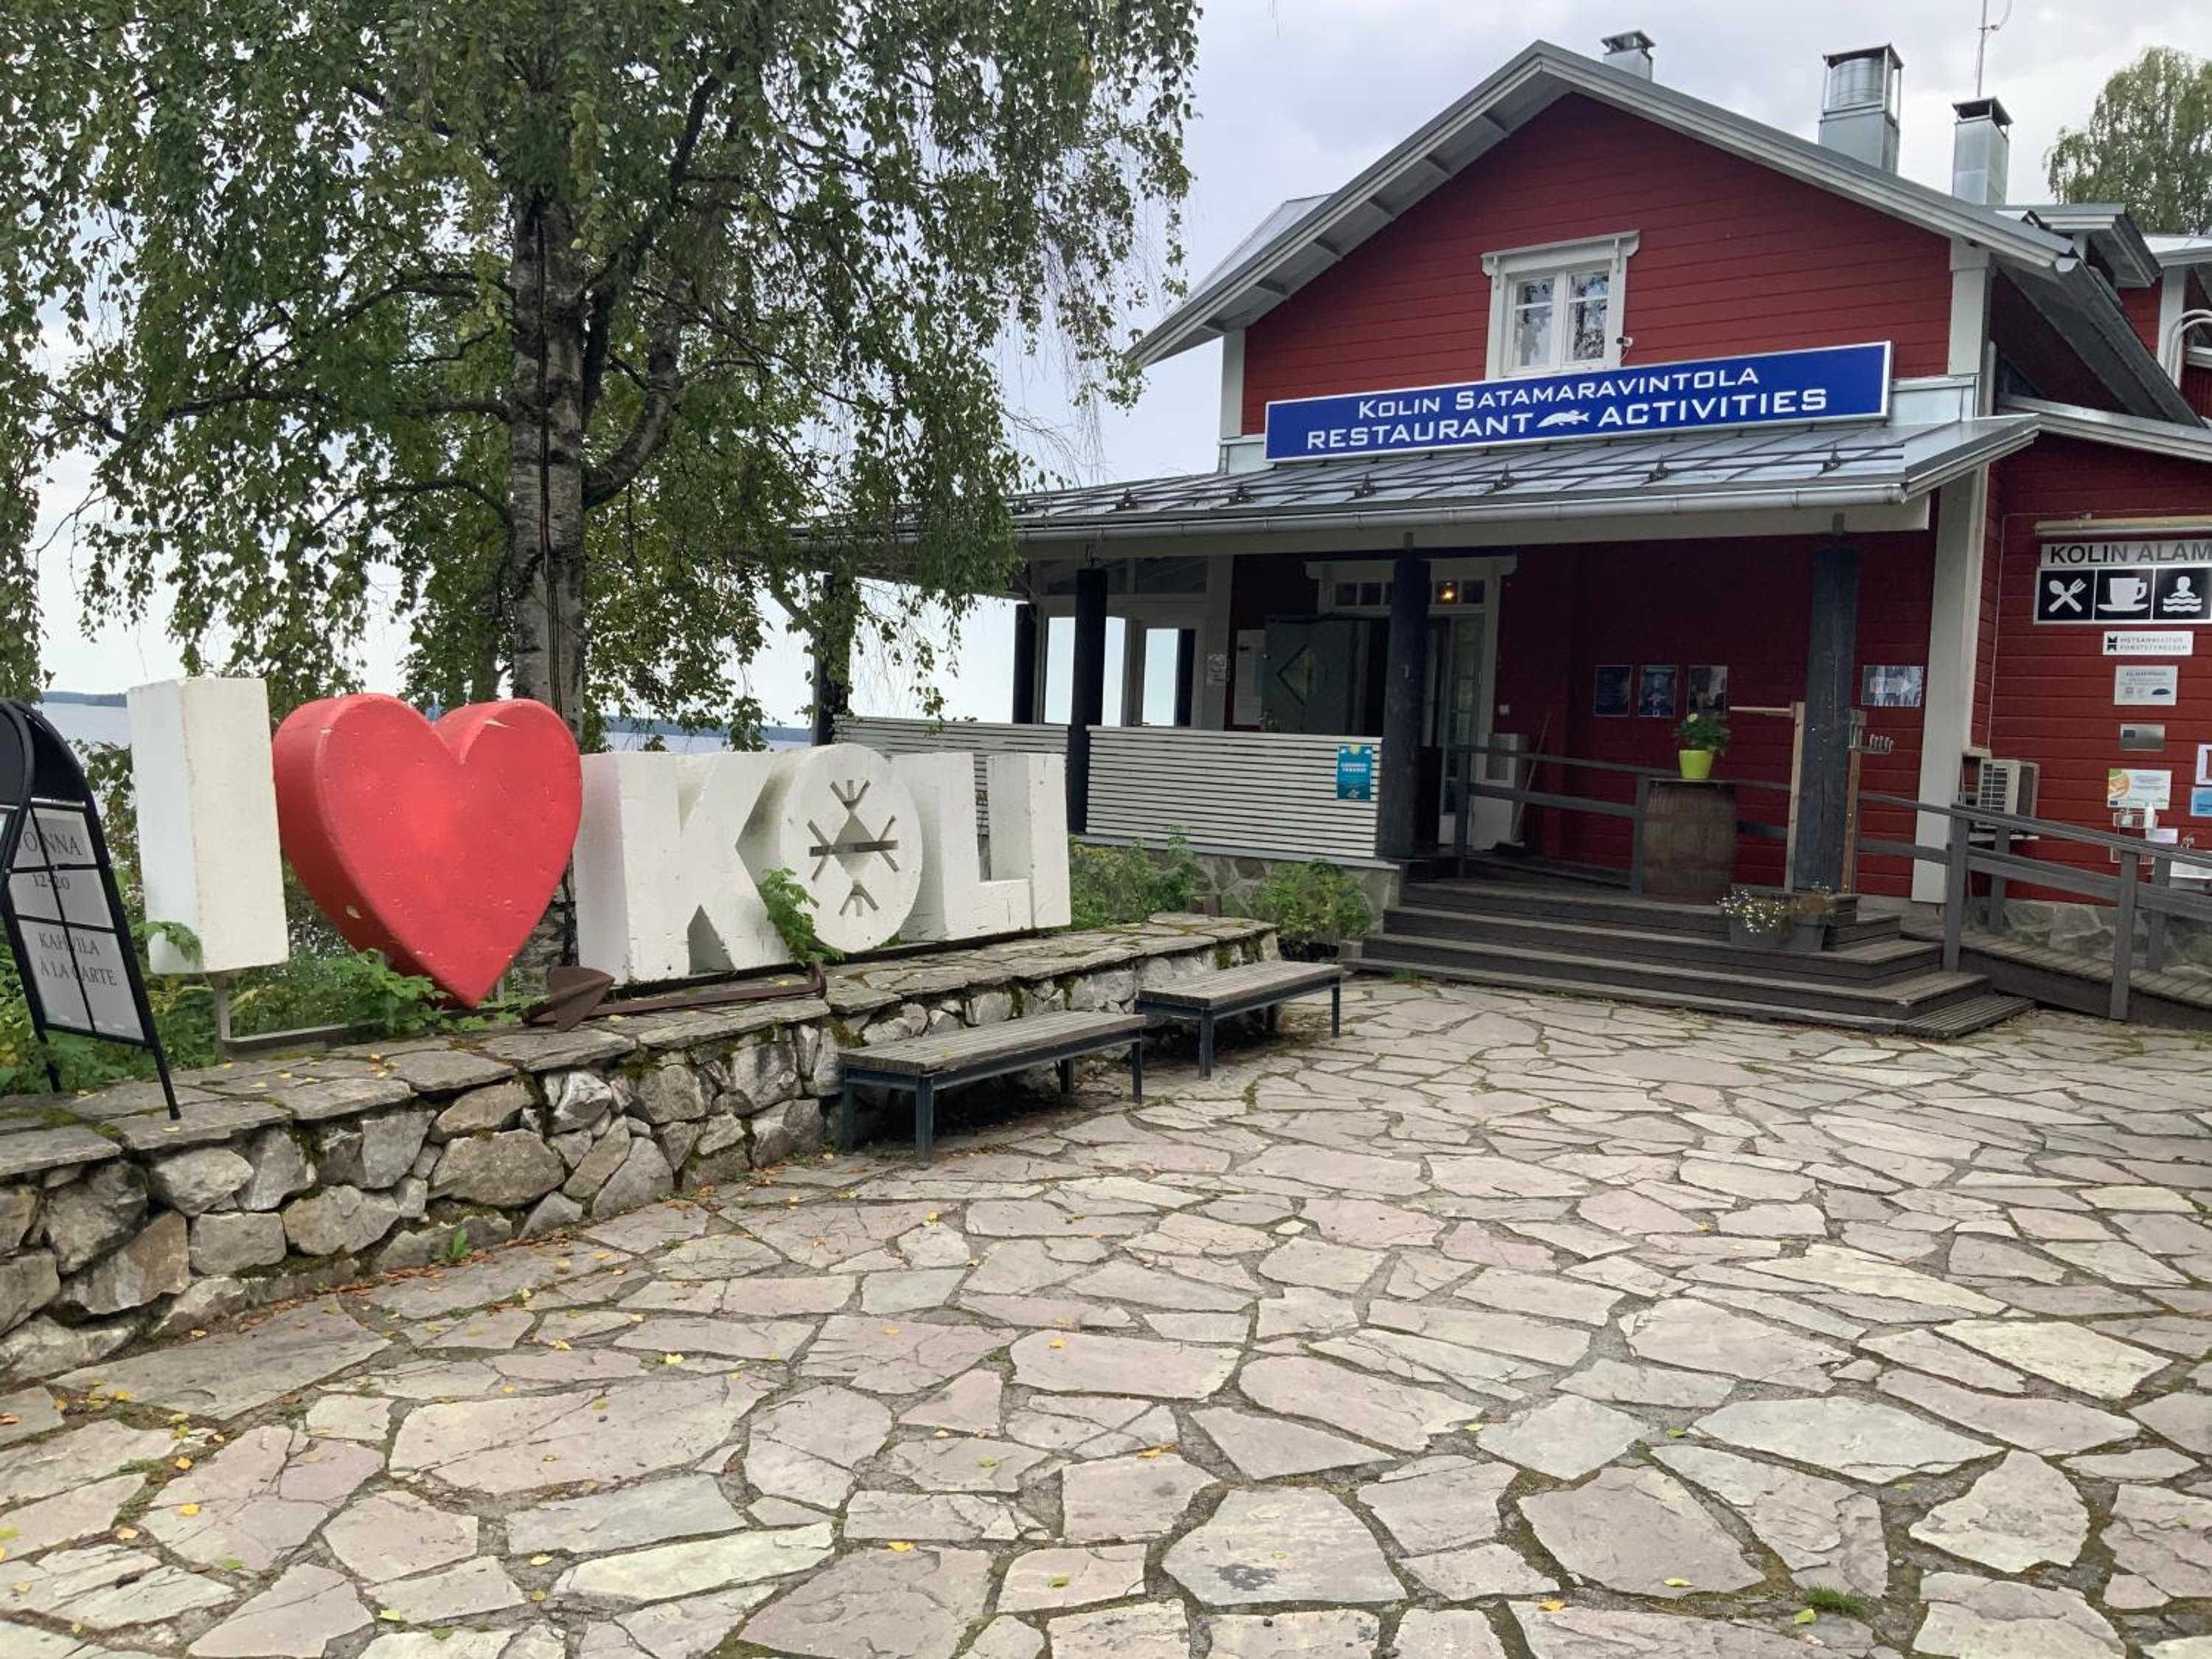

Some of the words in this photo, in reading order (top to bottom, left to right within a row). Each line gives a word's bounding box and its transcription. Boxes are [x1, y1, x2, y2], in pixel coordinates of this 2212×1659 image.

[1307, 412, 1534, 449] RESTAURANT
[1597, 388, 1828, 427] ACTIVITIES
[1358, 397, 1440, 419] KOLIN
[1455, 367, 1759, 411] SATAMARAVINTOLA
[2050, 544, 2127, 563] KOLIN
[128, 677, 290, 975] I
[574, 742, 1071, 986] KOLI
